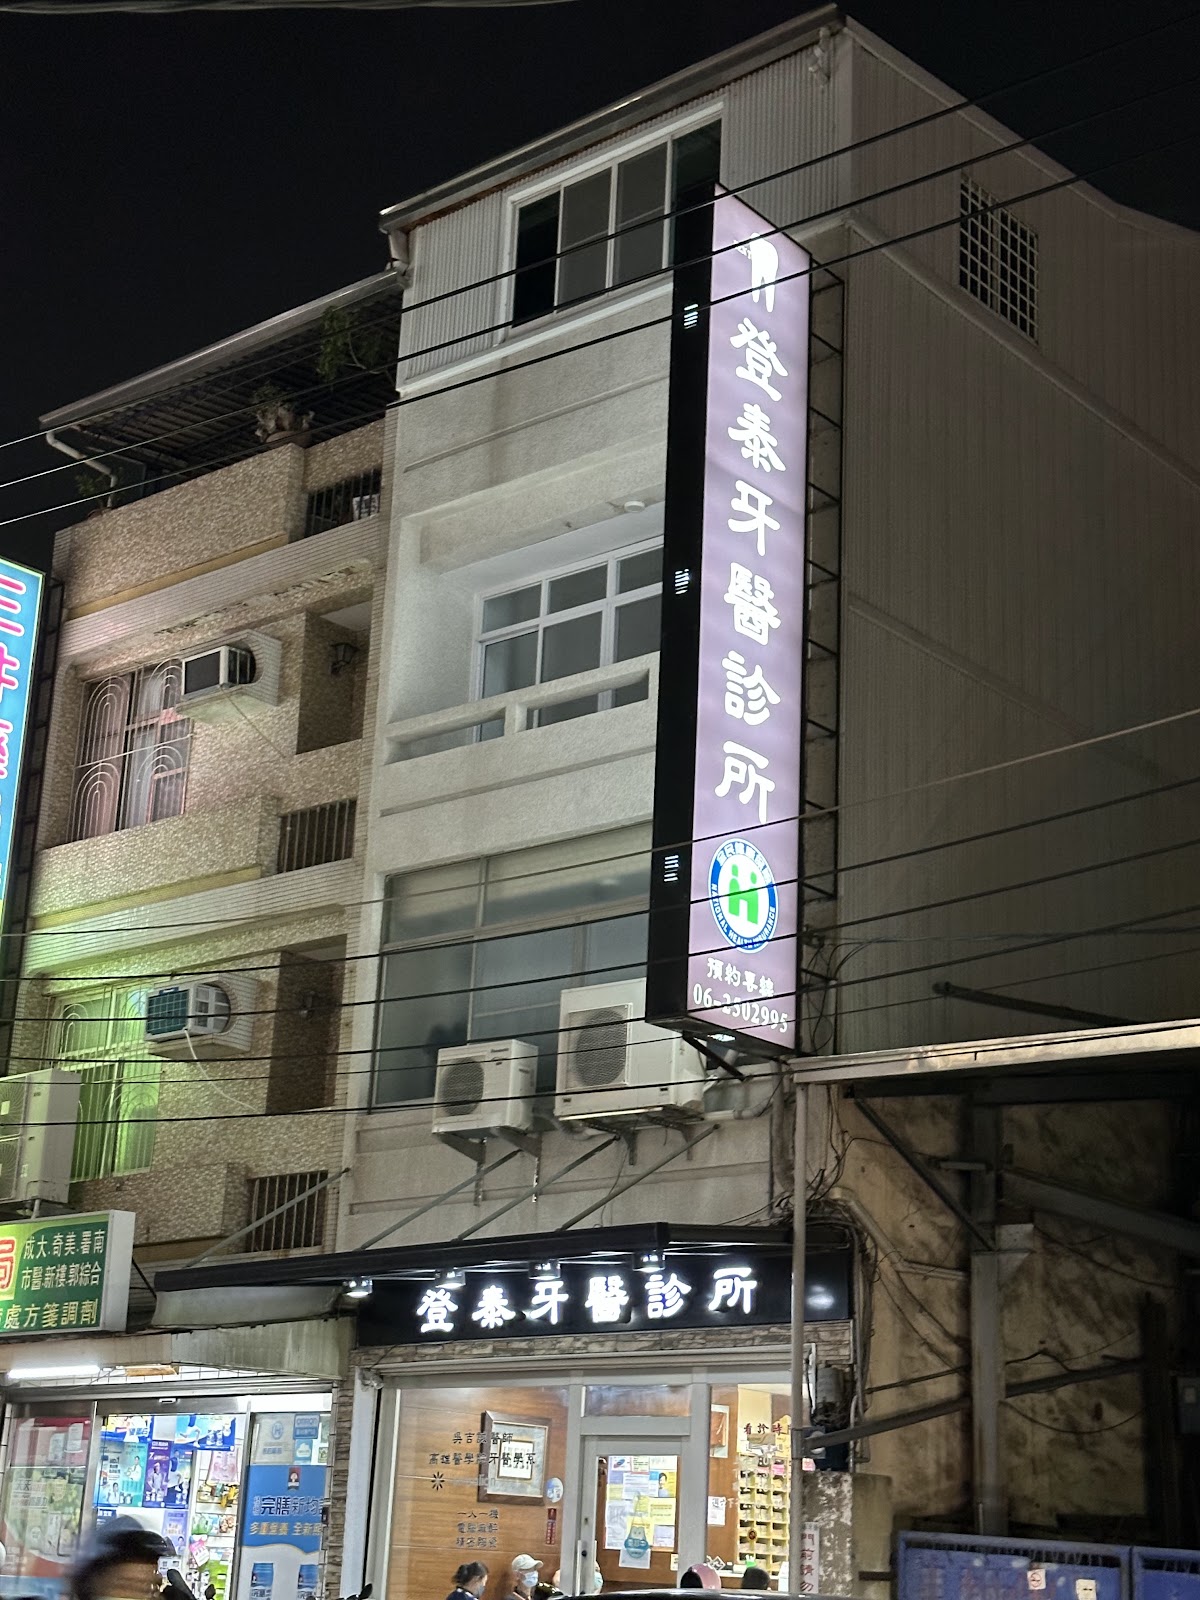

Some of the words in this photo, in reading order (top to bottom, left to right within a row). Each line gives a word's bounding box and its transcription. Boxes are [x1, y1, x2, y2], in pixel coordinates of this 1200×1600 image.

[714, 317, 789, 825] 登泰牙醫診所
[707, 957, 774, 997] 預約專線
[0, 1298, 99, 1329] 處方箋調劑
[416, 1267, 758, 1333] 登泰牙醫診所
[743, 1422, 791, 1436] 看診時
